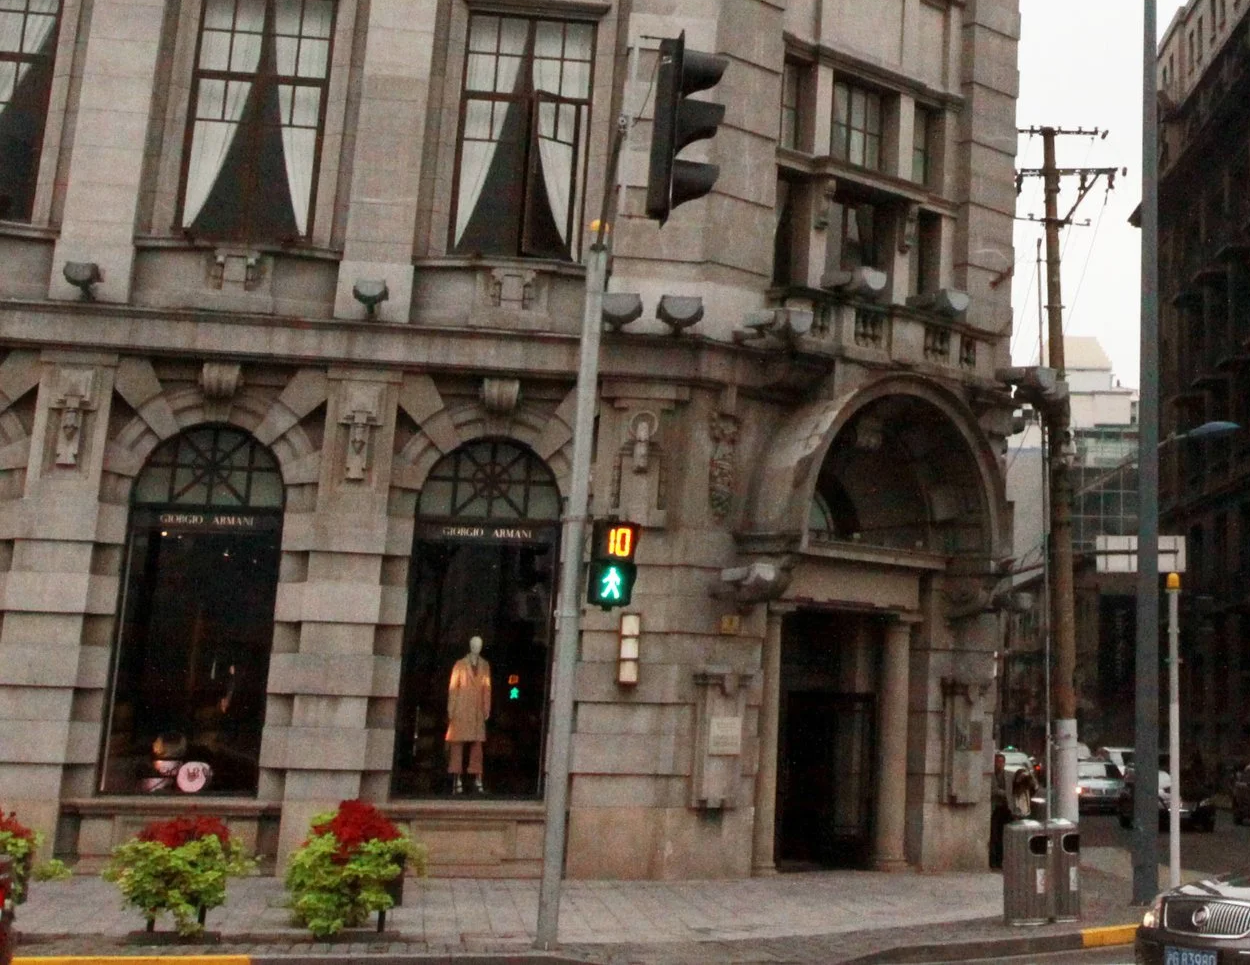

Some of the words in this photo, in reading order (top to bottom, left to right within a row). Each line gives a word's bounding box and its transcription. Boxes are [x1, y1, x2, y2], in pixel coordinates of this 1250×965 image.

[159, 514, 204, 524] GIORGIO
[212, 515, 255, 527] ARMANI
[442, 527, 485, 537] GIORGIO
[493, 528, 533, 539] ARMANI
[608, 527, 632, 557] 10
